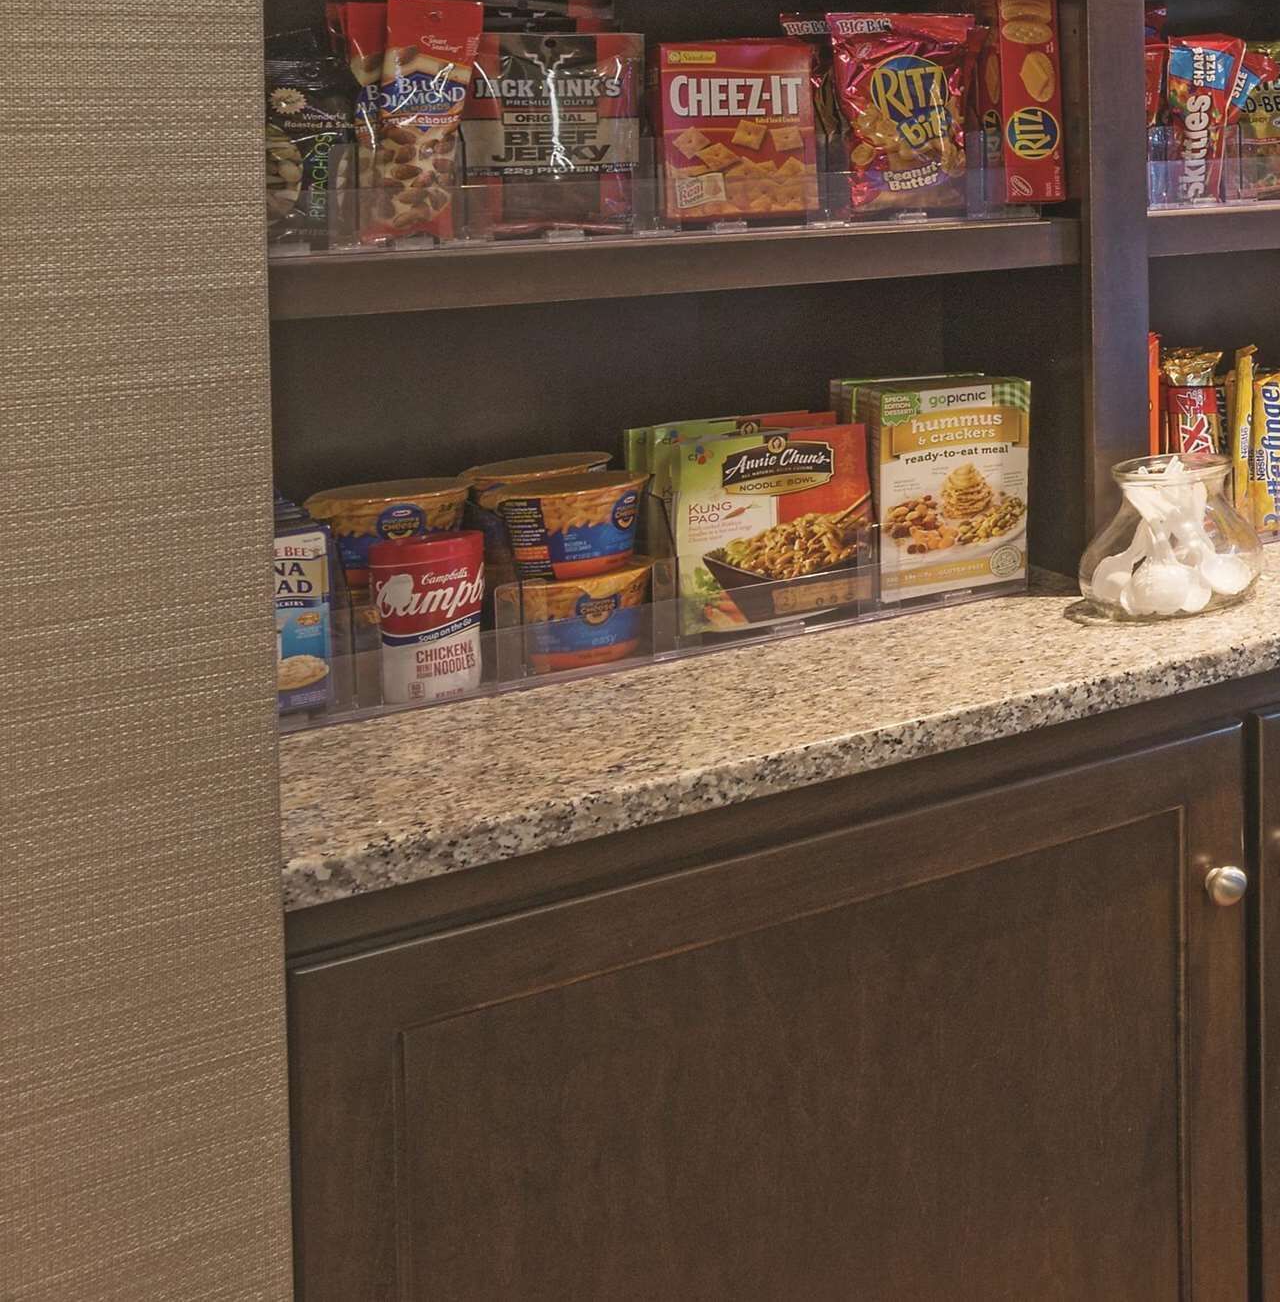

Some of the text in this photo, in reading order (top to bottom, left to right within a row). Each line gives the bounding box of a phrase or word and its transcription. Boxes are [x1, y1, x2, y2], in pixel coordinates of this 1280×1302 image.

[837, 19, 865, 34] BIG
[1193, 47, 1204, 87] SHARE
[1207, 54, 1217, 82] SIZE
[476, 79, 534, 98] JACK
[670, 75, 802, 116] CHEEZ-IT
[874, 66, 944, 124] RITZ
[1232, 72, 1248, 98] SIZE
[381, 86, 466, 108] DIAMOND
[503, 130, 597, 146] BEEF
[1014, 110, 1052, 157] RITZ
[1180, 94, 1212, 204] Skittles
[309, 135, 333, 218] PISTACHIOS
[503, 167, 534, 175] 22g
[537, 166, 600, 174] PROTEIN
[888, 173, 938, 191] Butter
[928, 391, 987, 408] gopicnic
[911, 413, 1003, 434] hummus
[930, 428, 996, 442] crackers
[725, 448, 831, 481] Annie Chun's
[905, 445, 1009, 465] ready-to-eat meal
[739, 476, 817, 492] NOODLE BOWL
[689, 501, 733, 515] KUNG
[689, 513, 720, 525] PAO
[418, 633, 440, 643] Soup
[440, 628, 451, 638] on
[451, 623, 462, 633] the
[416, 642, 467, 664] CHICKEN
[434, 653, 476, 677] NOODLES
